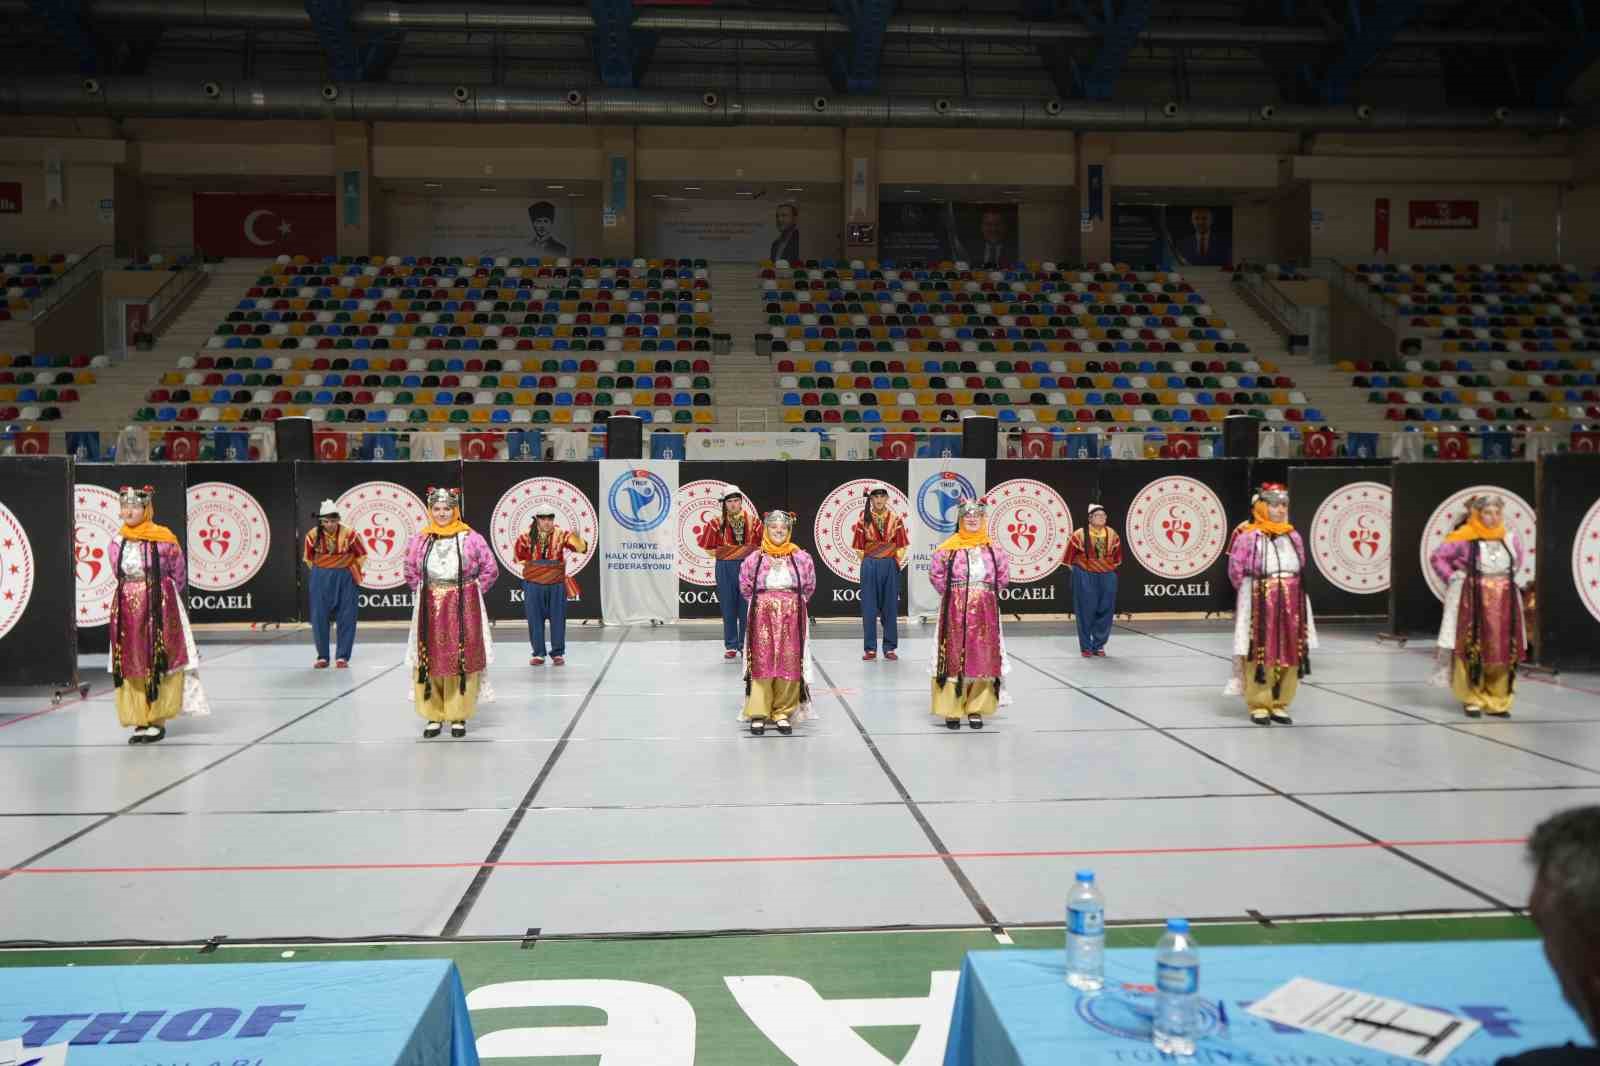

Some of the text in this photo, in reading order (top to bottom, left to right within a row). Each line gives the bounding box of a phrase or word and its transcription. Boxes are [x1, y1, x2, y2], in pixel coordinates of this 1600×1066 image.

[605, 552, 674, 560] HALK OYUNLARI
[913, 553, 931, 561] HAL
[608, 562, 671, 570] FEDERASYONU
[998, 585, 1056, 601] OCAELİ
[1143, 581, 1211, 597] KOCAELİ
[187, 592, 252, 610] OCAELİ
[357, 591, 417, 608] OCAELİ
[22, 1004, 307, 1048] THOF
